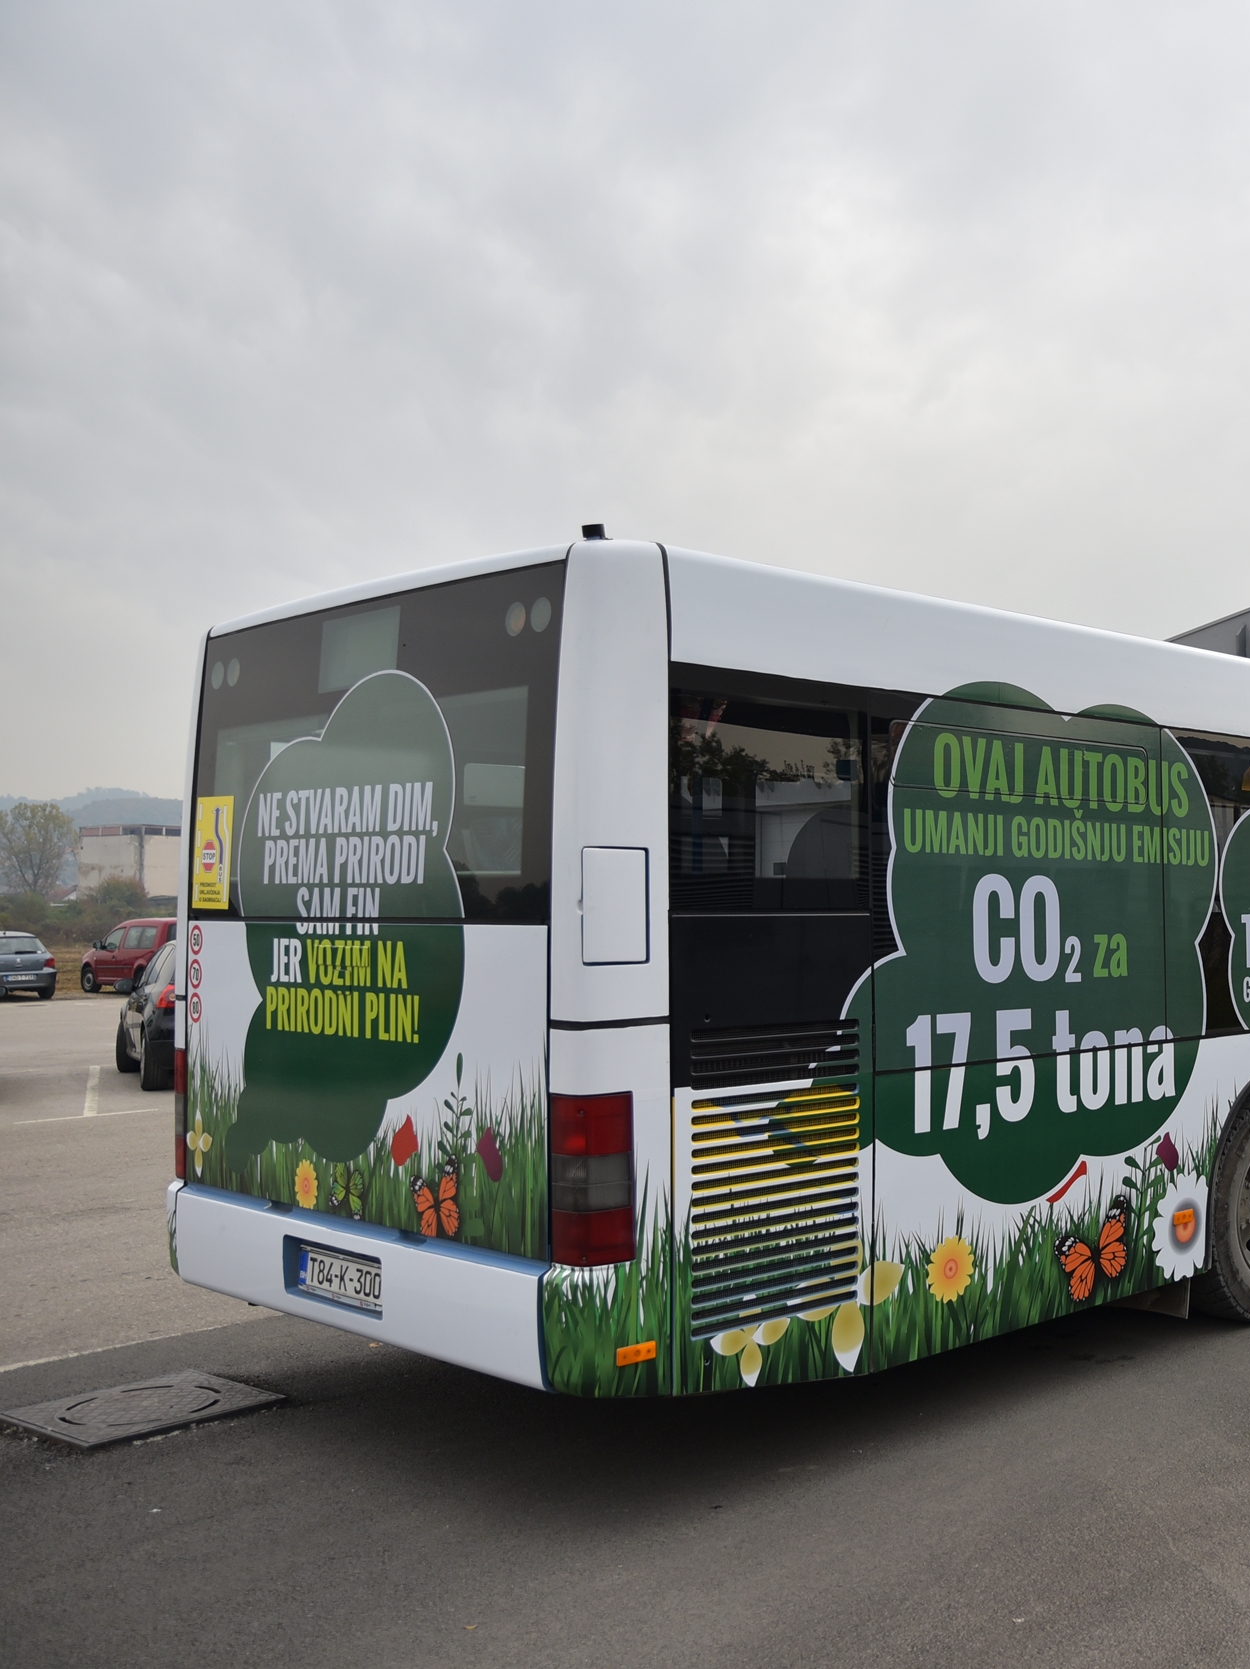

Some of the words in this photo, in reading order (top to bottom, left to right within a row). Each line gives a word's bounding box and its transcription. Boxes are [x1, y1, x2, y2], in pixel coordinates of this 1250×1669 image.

[933, 732, 1025, 804] OVAJ
[1035, 745, 1189, 818] AUTOBUS
[257, 792, 283, 837] NE
[284, 784, 382, 836] STVARAM
[387, 781, 439, 837] DIM,
[203, 852, 216, 860] STOP
[263, 837, 329, 884] PREMA
[333, 834, 426, 884] PRIRODI
[903, 808, 1004, 857] UMANJI
[1011, 809, 1126, 863] GODIŠNJU
[1132, 825, 1209, 867] EMISIJU
[295, 886, 341, 935] SAM
[345, 887, 380, 935] FIN
[192, 934, 200, 947] 50
[270, 938, 303, 983] JER
[306, 938, 371, 987] VOZIM
[377, 940, 408, 989] NA
[1093, 933, 1129, 978] za
[192, 966, 200, 981] 70
[192, 1001, 200, 1015] 80
[266, 986, 359, 1037] PRIRODNI
[365, 992, 420, 1043] PLIN!
[906, 1008, 1036, 1140] 17,5
[1052, 1009, 1176, 1114] tona
[310, 1257, 382, 1300] T84-K-300
